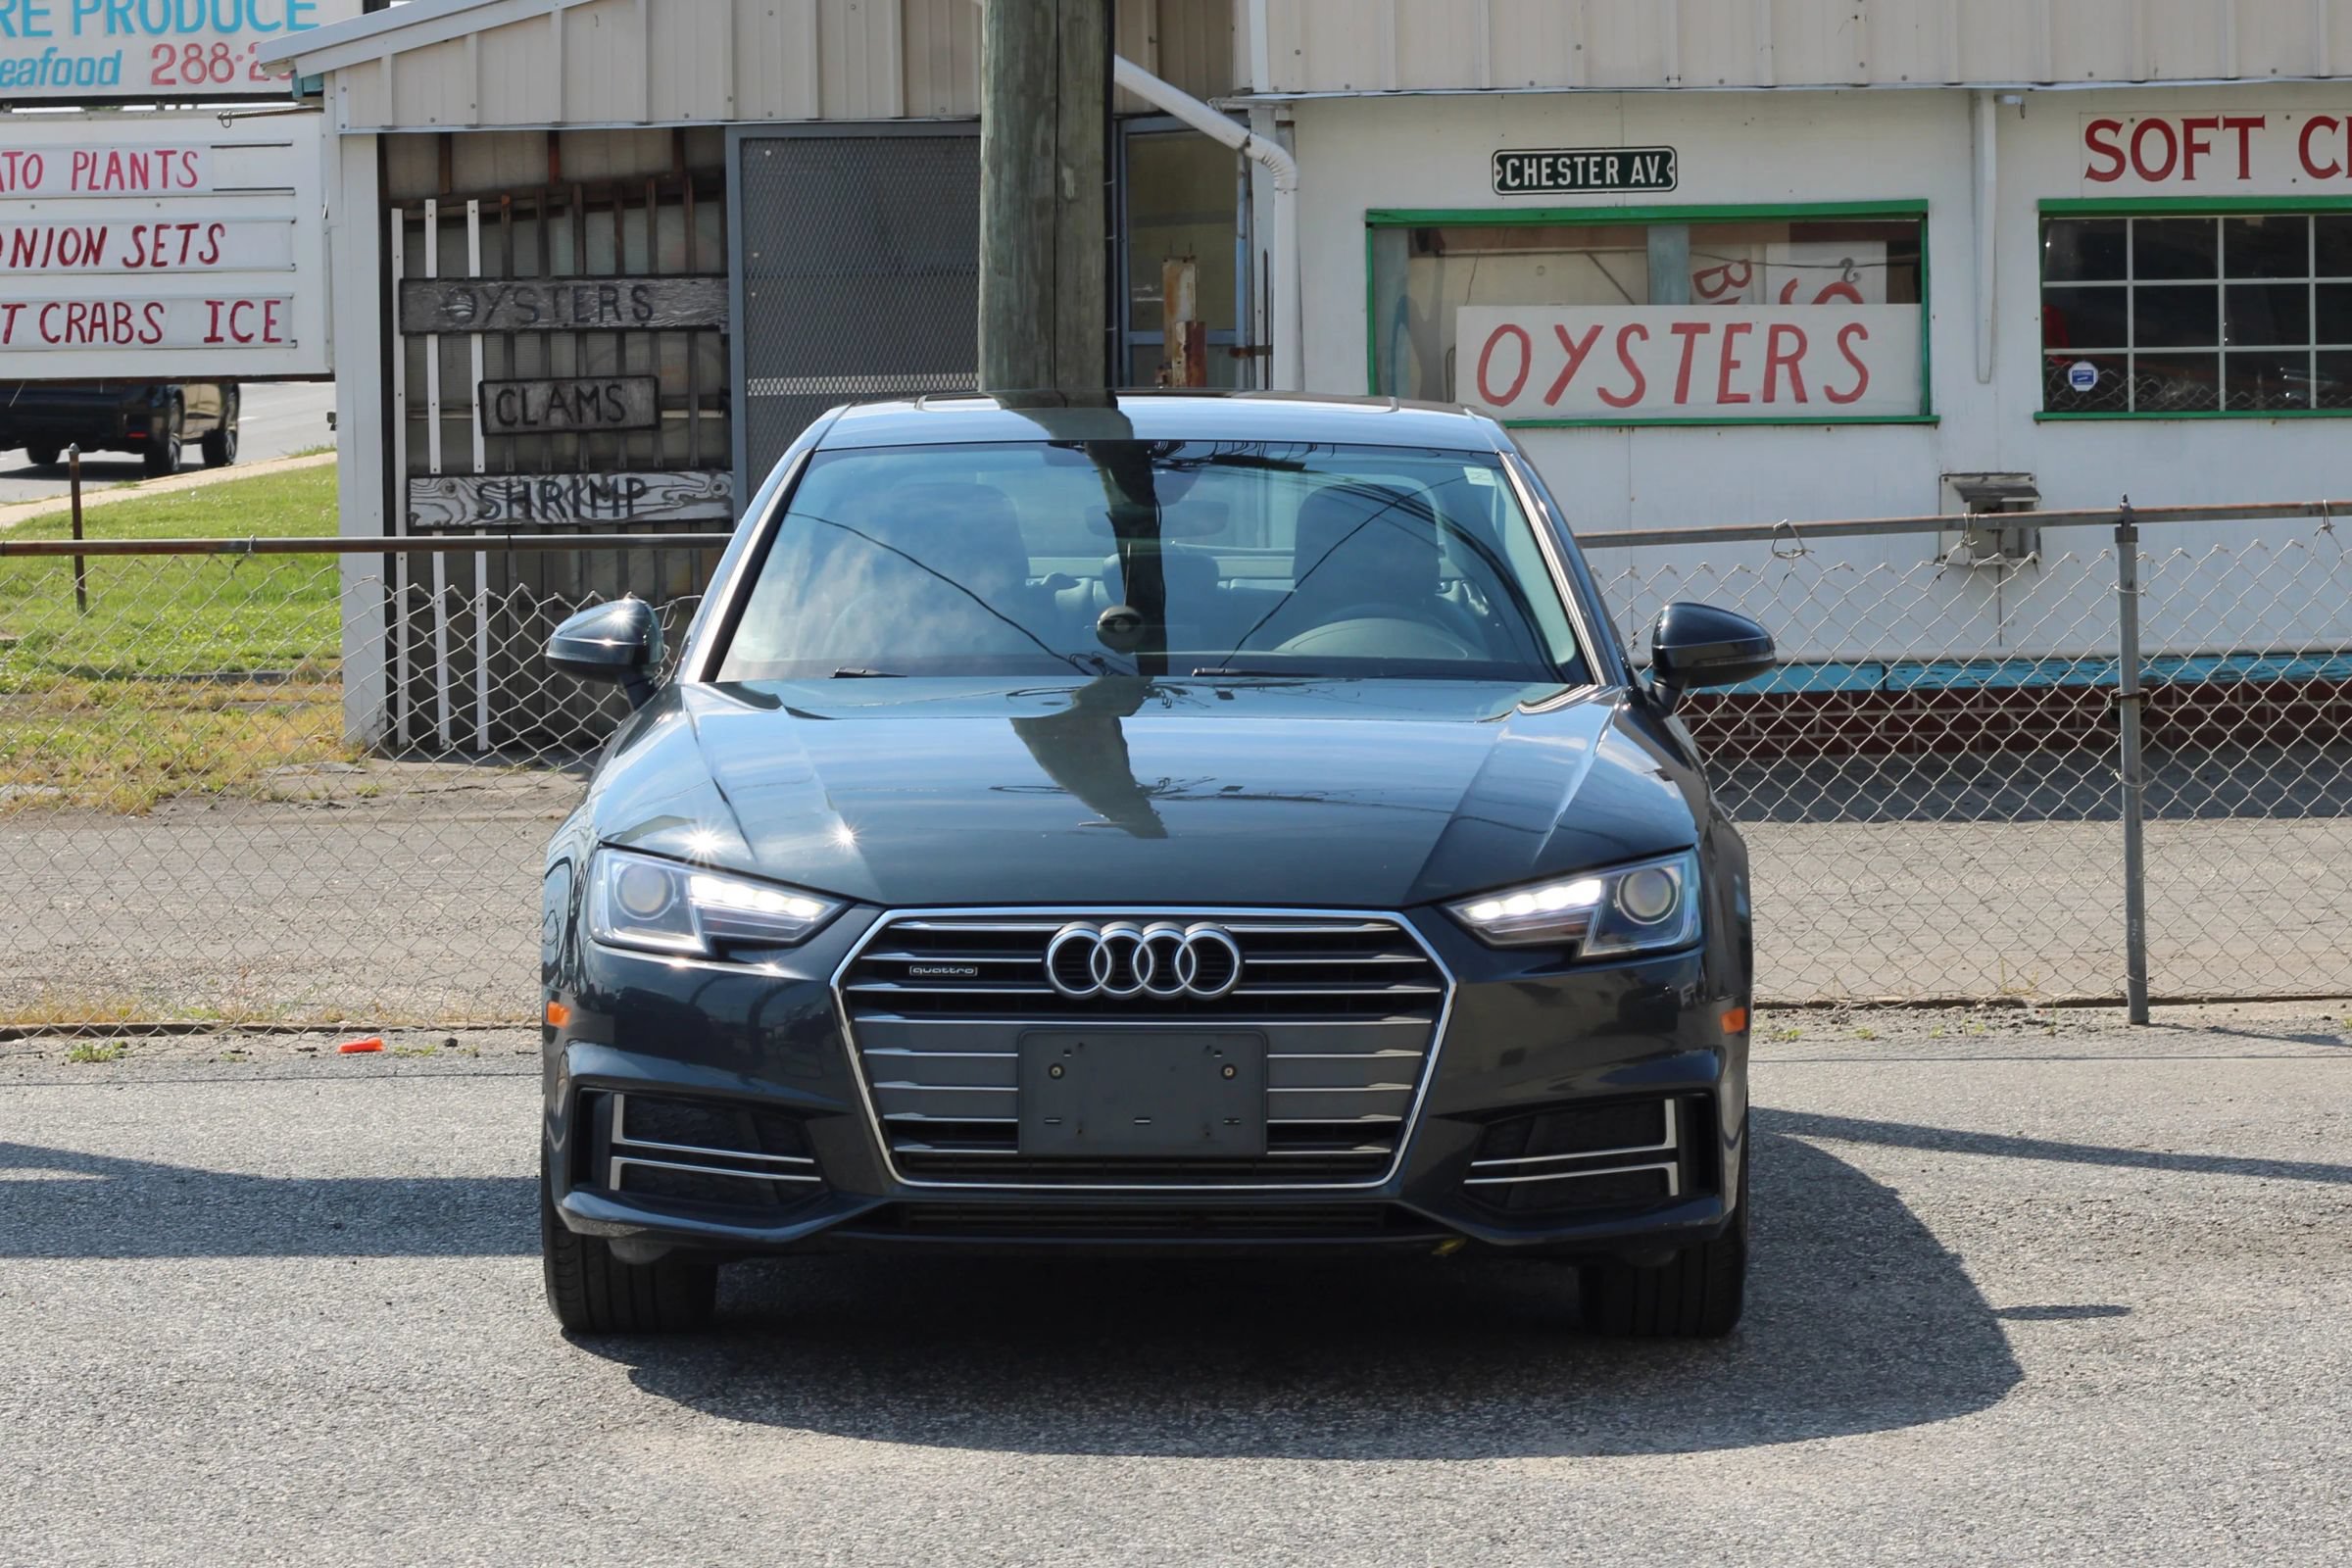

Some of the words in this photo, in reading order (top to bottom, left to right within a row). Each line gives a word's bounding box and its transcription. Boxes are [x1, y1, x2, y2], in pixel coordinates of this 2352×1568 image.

[73, 0, 319, 35] PRODUCE
[0, 47, 122, 87] eafood
[2084, 115, 2265, 182] SOFT
[2298, 115, 2352, 179] C
[0, 151, 43, 192] TO
[71, 150, 199, 191] PLANTS
[1505, 157, 1619, 187] CHESTER
[1630, 155, 1664, 184] AV.
[0, 225, 107, 268] NION
[122, 223, 225, 268] SETS
[1, 303, 27, 344] T
[39, 302, 165, 344] CRABS
[204, 300, 282, 343] ICE
[445, 283, 654, 324] OYSTERS
[1477, 322, 1869, 407] OYSTERS
[495, 384, 626, 427] CLAMS
[476, 477, 647, 520] SHRIMP
[912, 966, 974, 975] quattro
